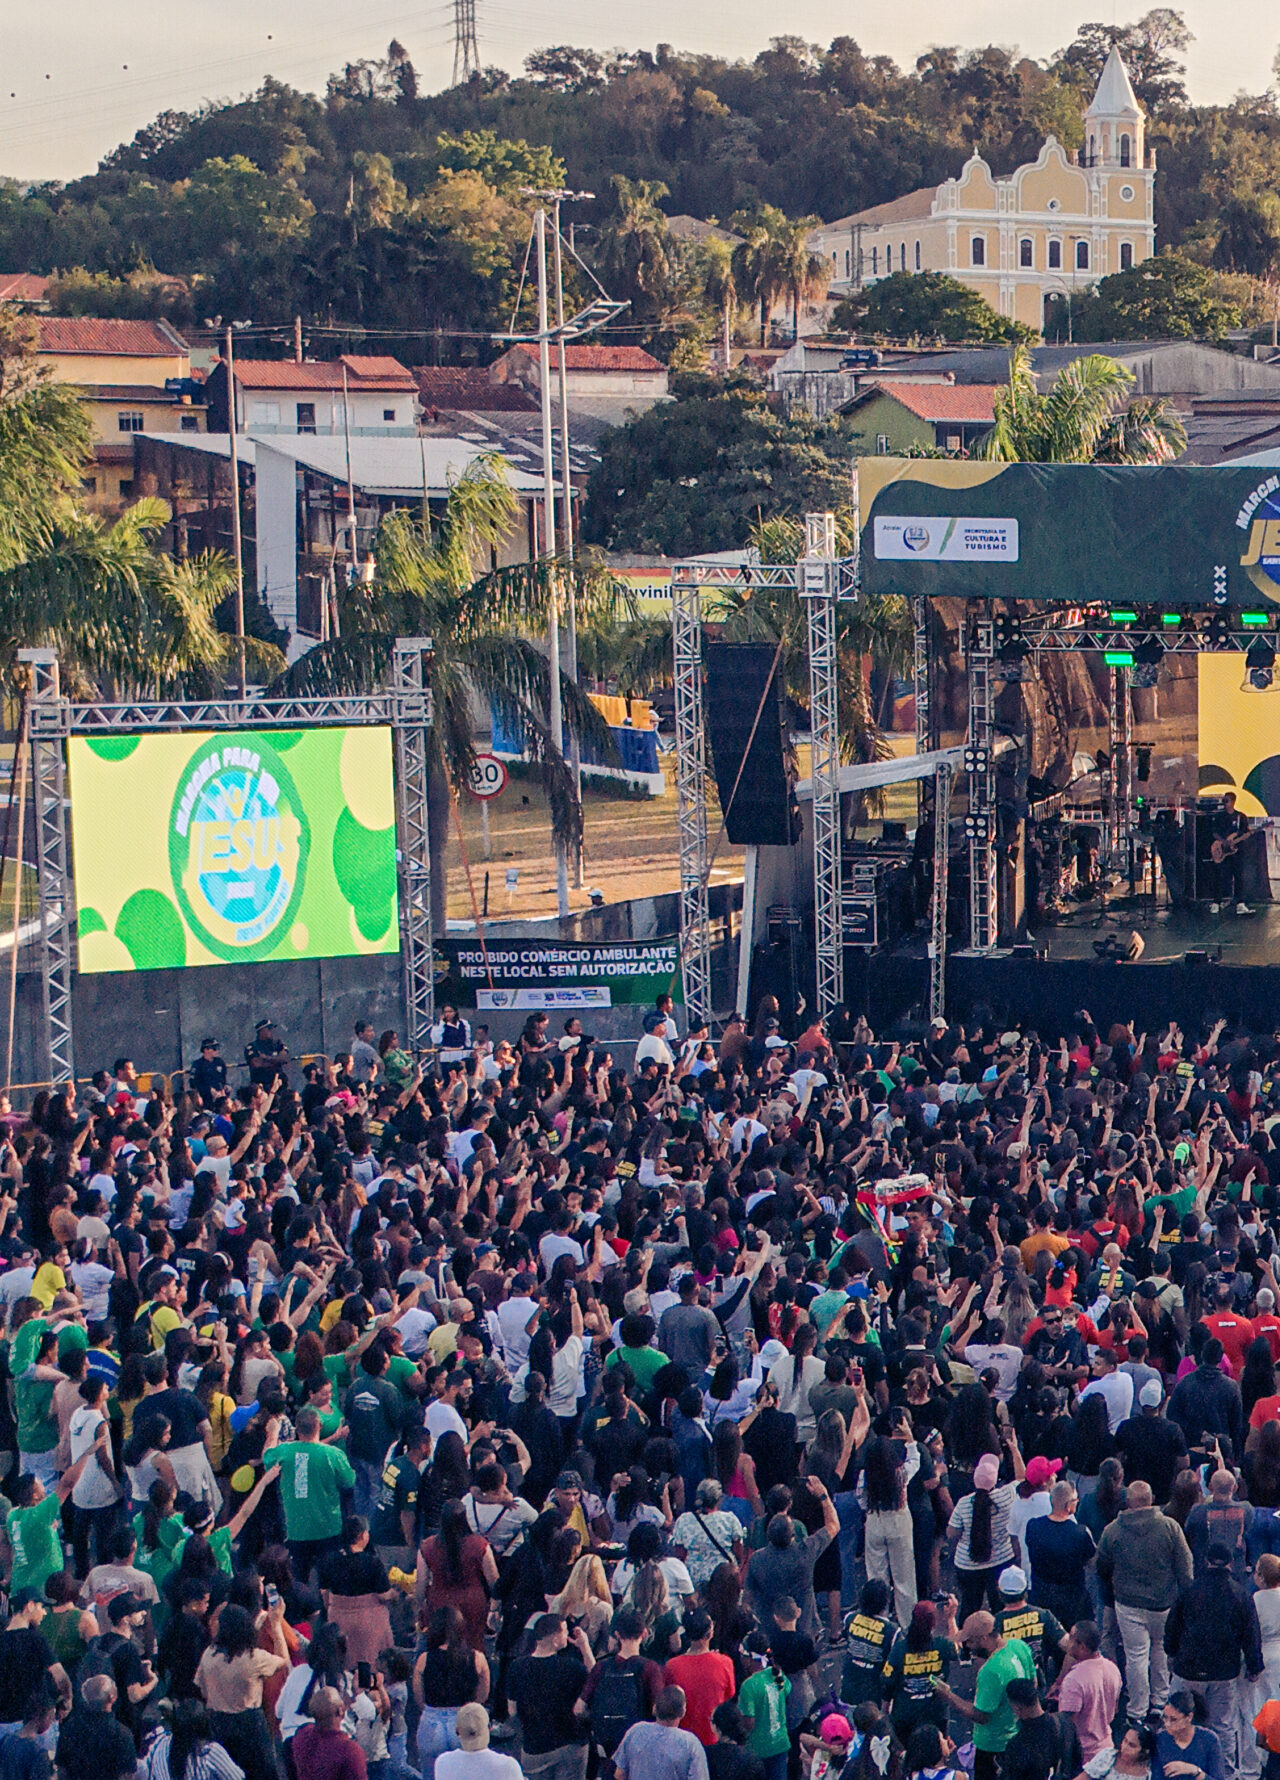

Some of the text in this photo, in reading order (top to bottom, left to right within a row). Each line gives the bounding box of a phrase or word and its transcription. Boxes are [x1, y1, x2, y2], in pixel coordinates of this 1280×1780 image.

[964, 535, 1007, 543] CULTURA E
[965, 543, 1007, 551] TURISMO
[457, 946, 677, 963] PROBIDO COMÉRCIO AMBULANTE
[460, 965, 502, 978] NESTE
[503, 965, 547, 978] LOCAL
[548, 964, 578, 977] SEM
[580, 960, 676, 977] AUTORIZAÇÃO
[853, 1613, 885, 1633] DEUS
[1003, 1611, 1039, 1631] DEUS
[848, 1622, 885, 1645] FORTE
[903, 1660, 944, 1675] FORTE
